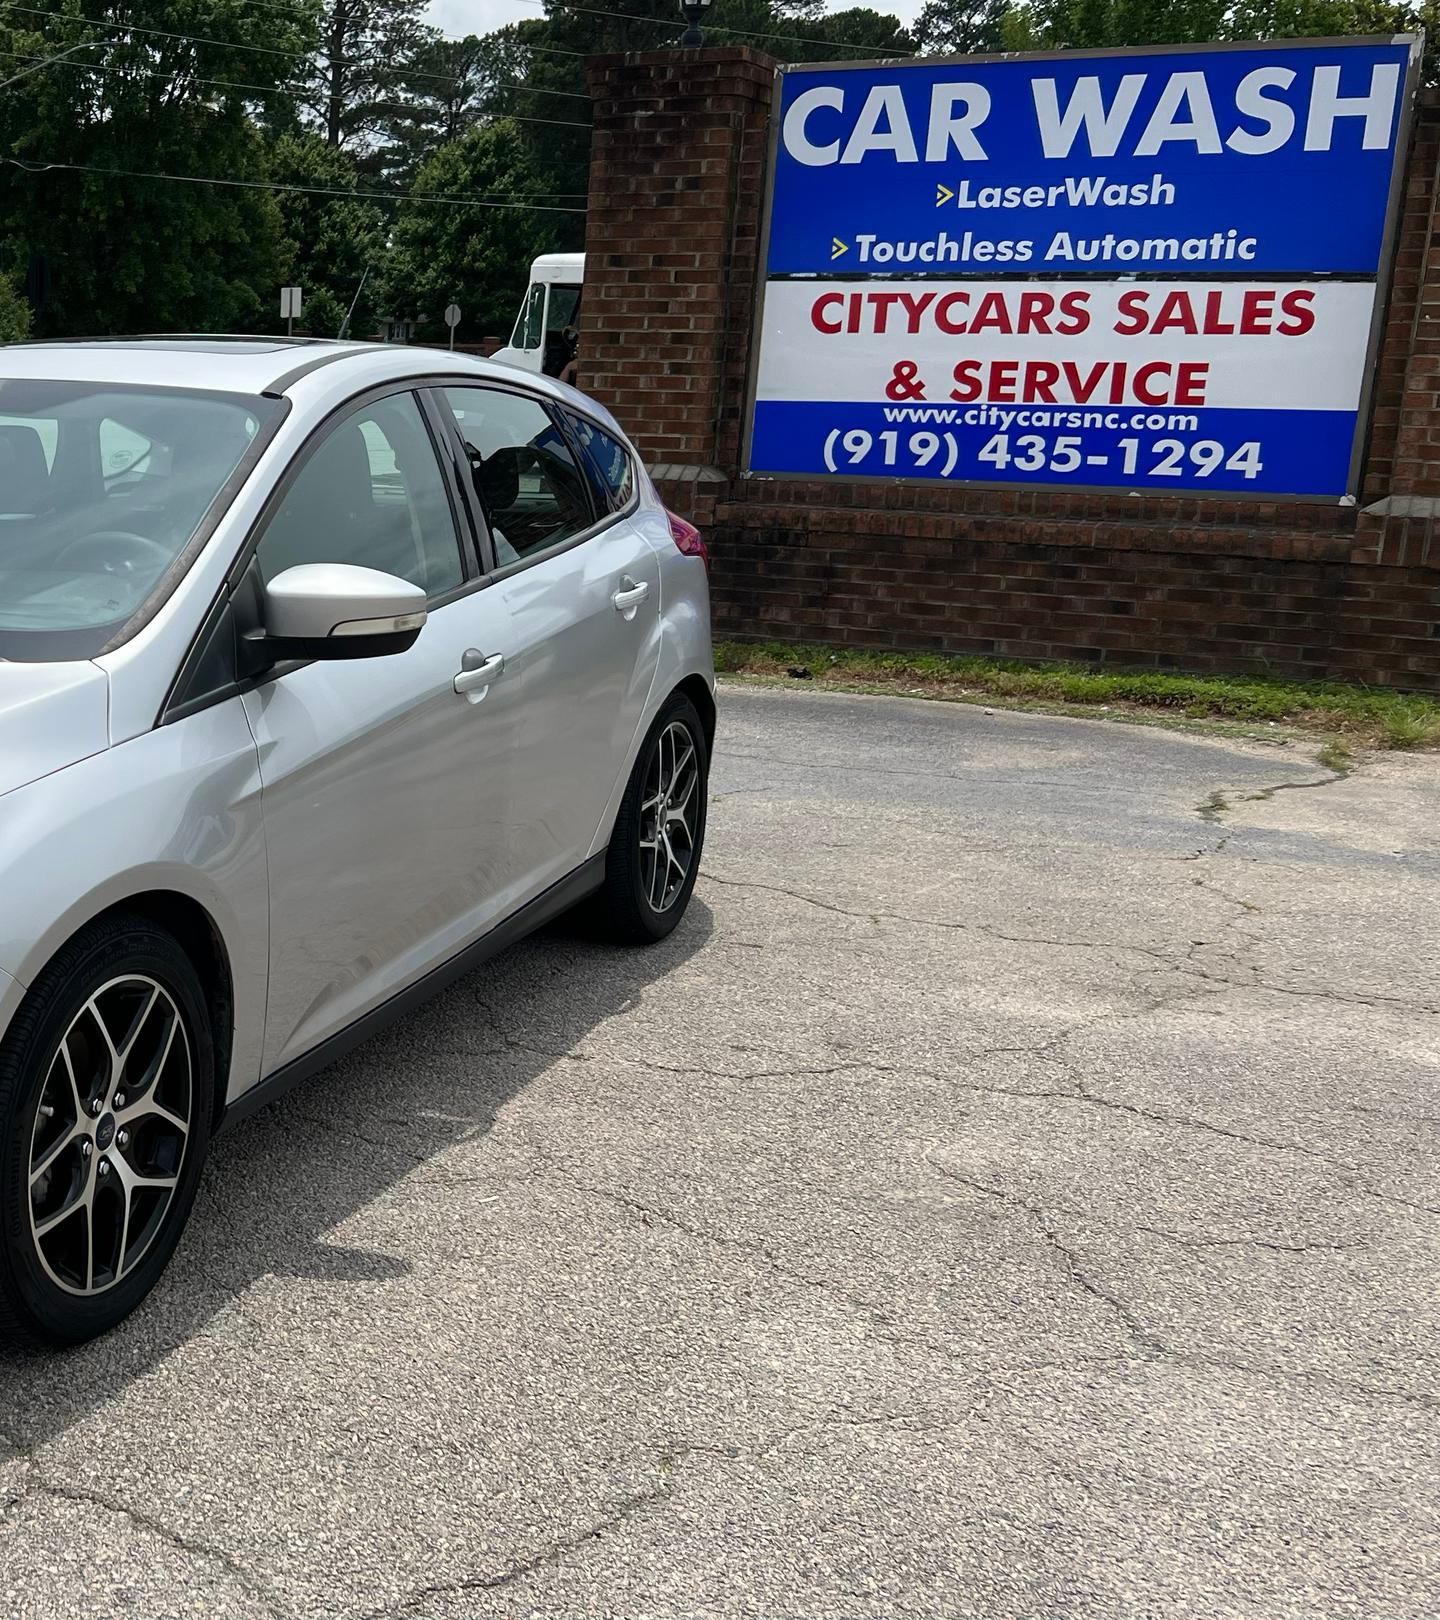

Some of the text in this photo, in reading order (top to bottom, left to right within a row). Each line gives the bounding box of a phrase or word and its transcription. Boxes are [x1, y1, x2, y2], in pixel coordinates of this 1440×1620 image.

[783, 63, 1400, 167] CAR WASH
[958, 173, 1176, 209] LaserWash
[855, 229, 1257, 263] Touchless Automatic
[811, 289, 1316, 336] CITYCARS SALES
[885, 359, 1210, 406] & SERVICE
[883, 404, 1199, 432] www.citycarsnc.com
[823, 428, 1263, 479] (919) 435-1294
